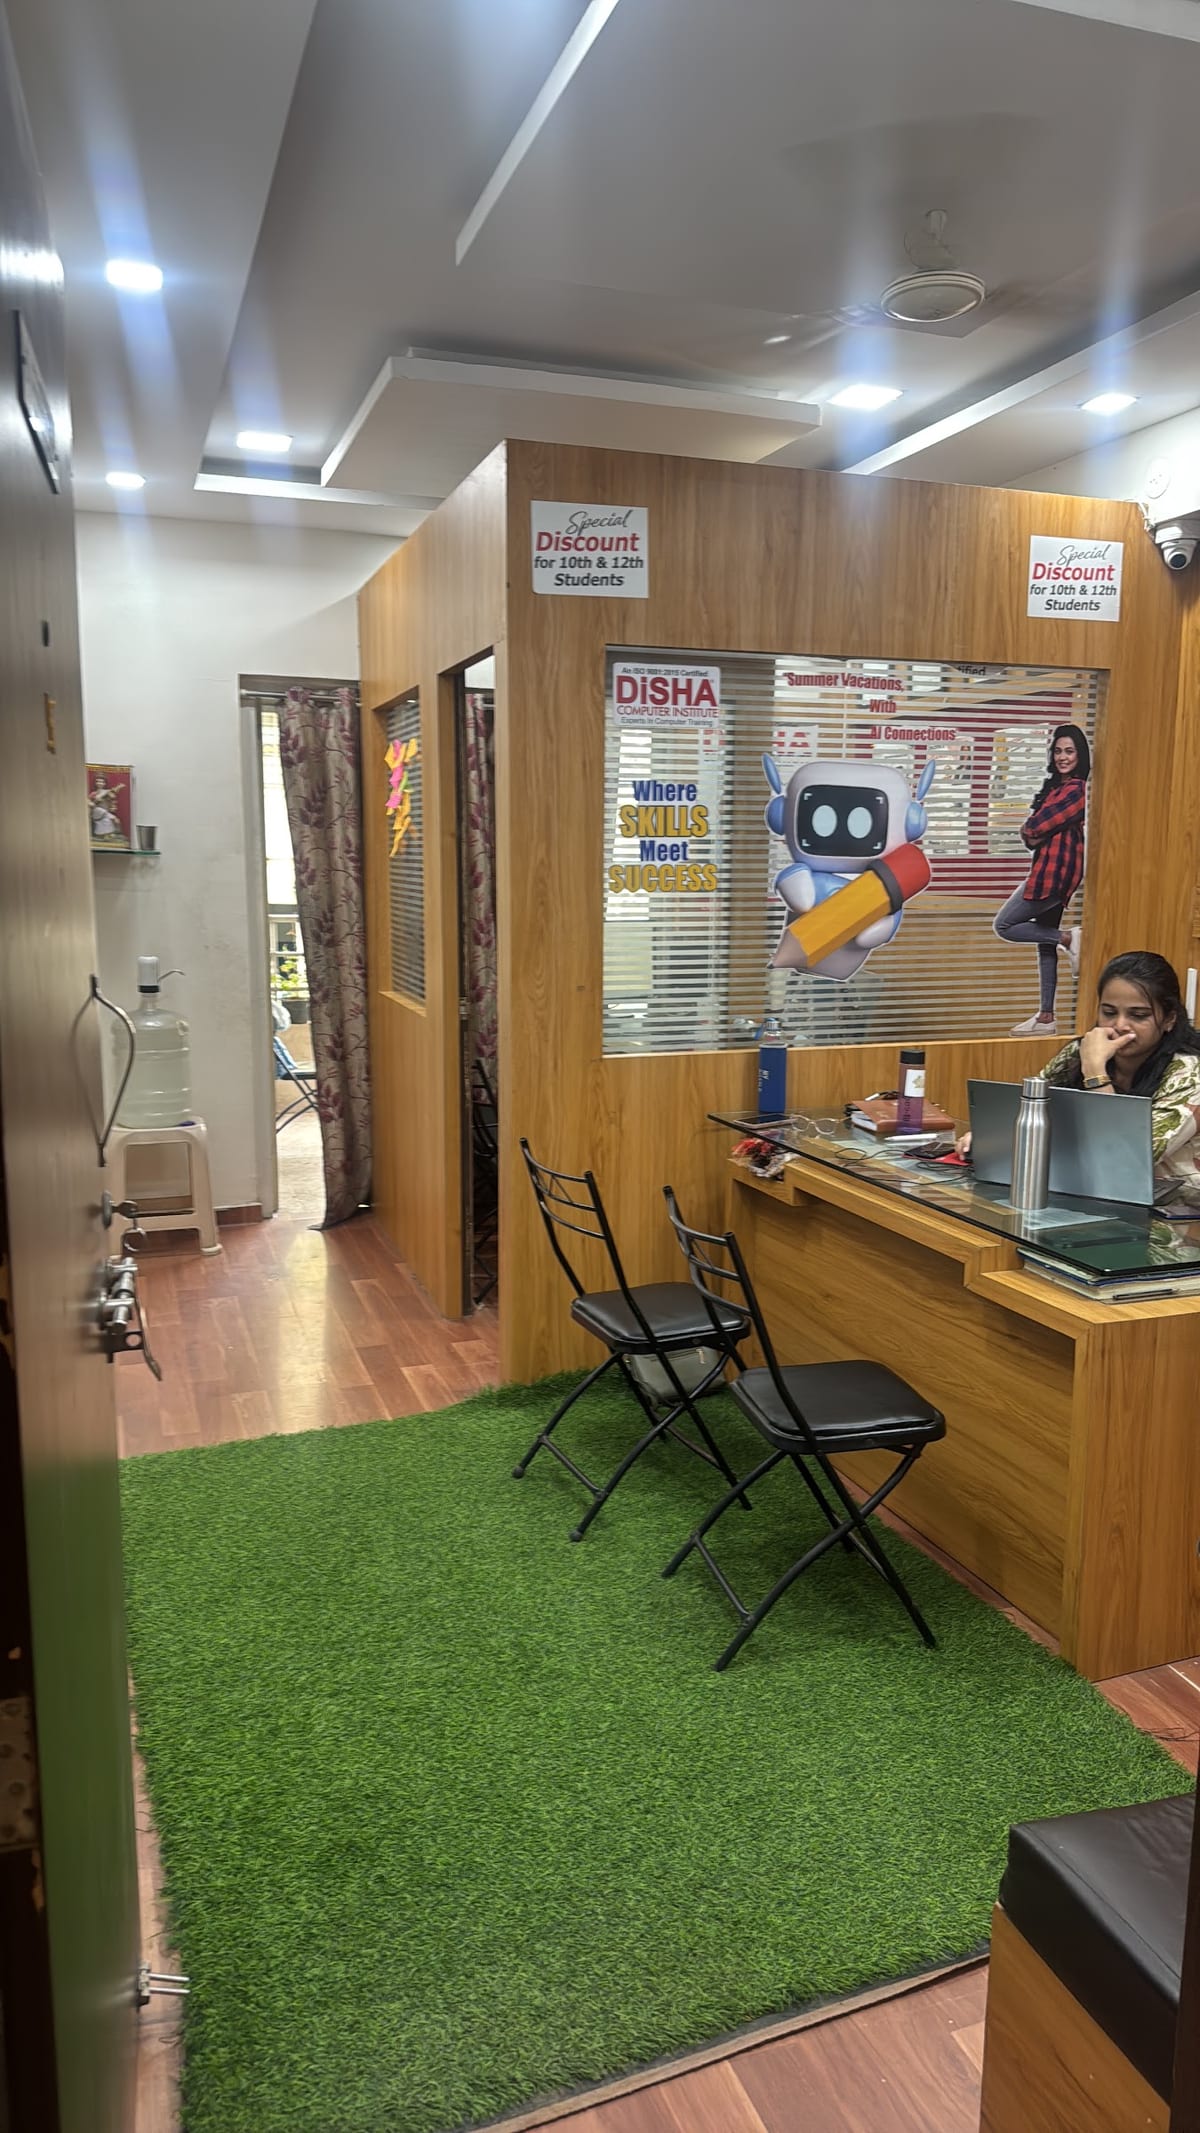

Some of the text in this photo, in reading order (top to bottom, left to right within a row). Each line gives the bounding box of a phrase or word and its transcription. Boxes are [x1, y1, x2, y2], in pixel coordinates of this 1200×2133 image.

[565, 509, 633, 536] Special
[536, 531, 640, 552] Discount
[534, 555, 644, 568] for 10th & 12th
[1056, 544, 1112, 567] Special
[554, 572, 625, 586] Students
[1032, 562, 1116, 581] Discount
[1030, 584, 1117, 595] for 10th & 12th
[1044, 598, 1101, 611] Students
[633, 667, 645, 675] ISO
[616, 675, 718, 707] DiSHA
[841, 674, 905, 692] Vacations,
[617, 705, 720, 718] COMPUTER INSTITUTE
[869, 699, 897, 713] With
[655, 718, 687, 726] Computer
[870, 726, 881, 739] AI
[633, 780, 697, 801] Where
[620, 804, 709, 838] SKILLS
[640, 840, 688, 862] Meet
[608, 864, 718, 893] SUCCESS
